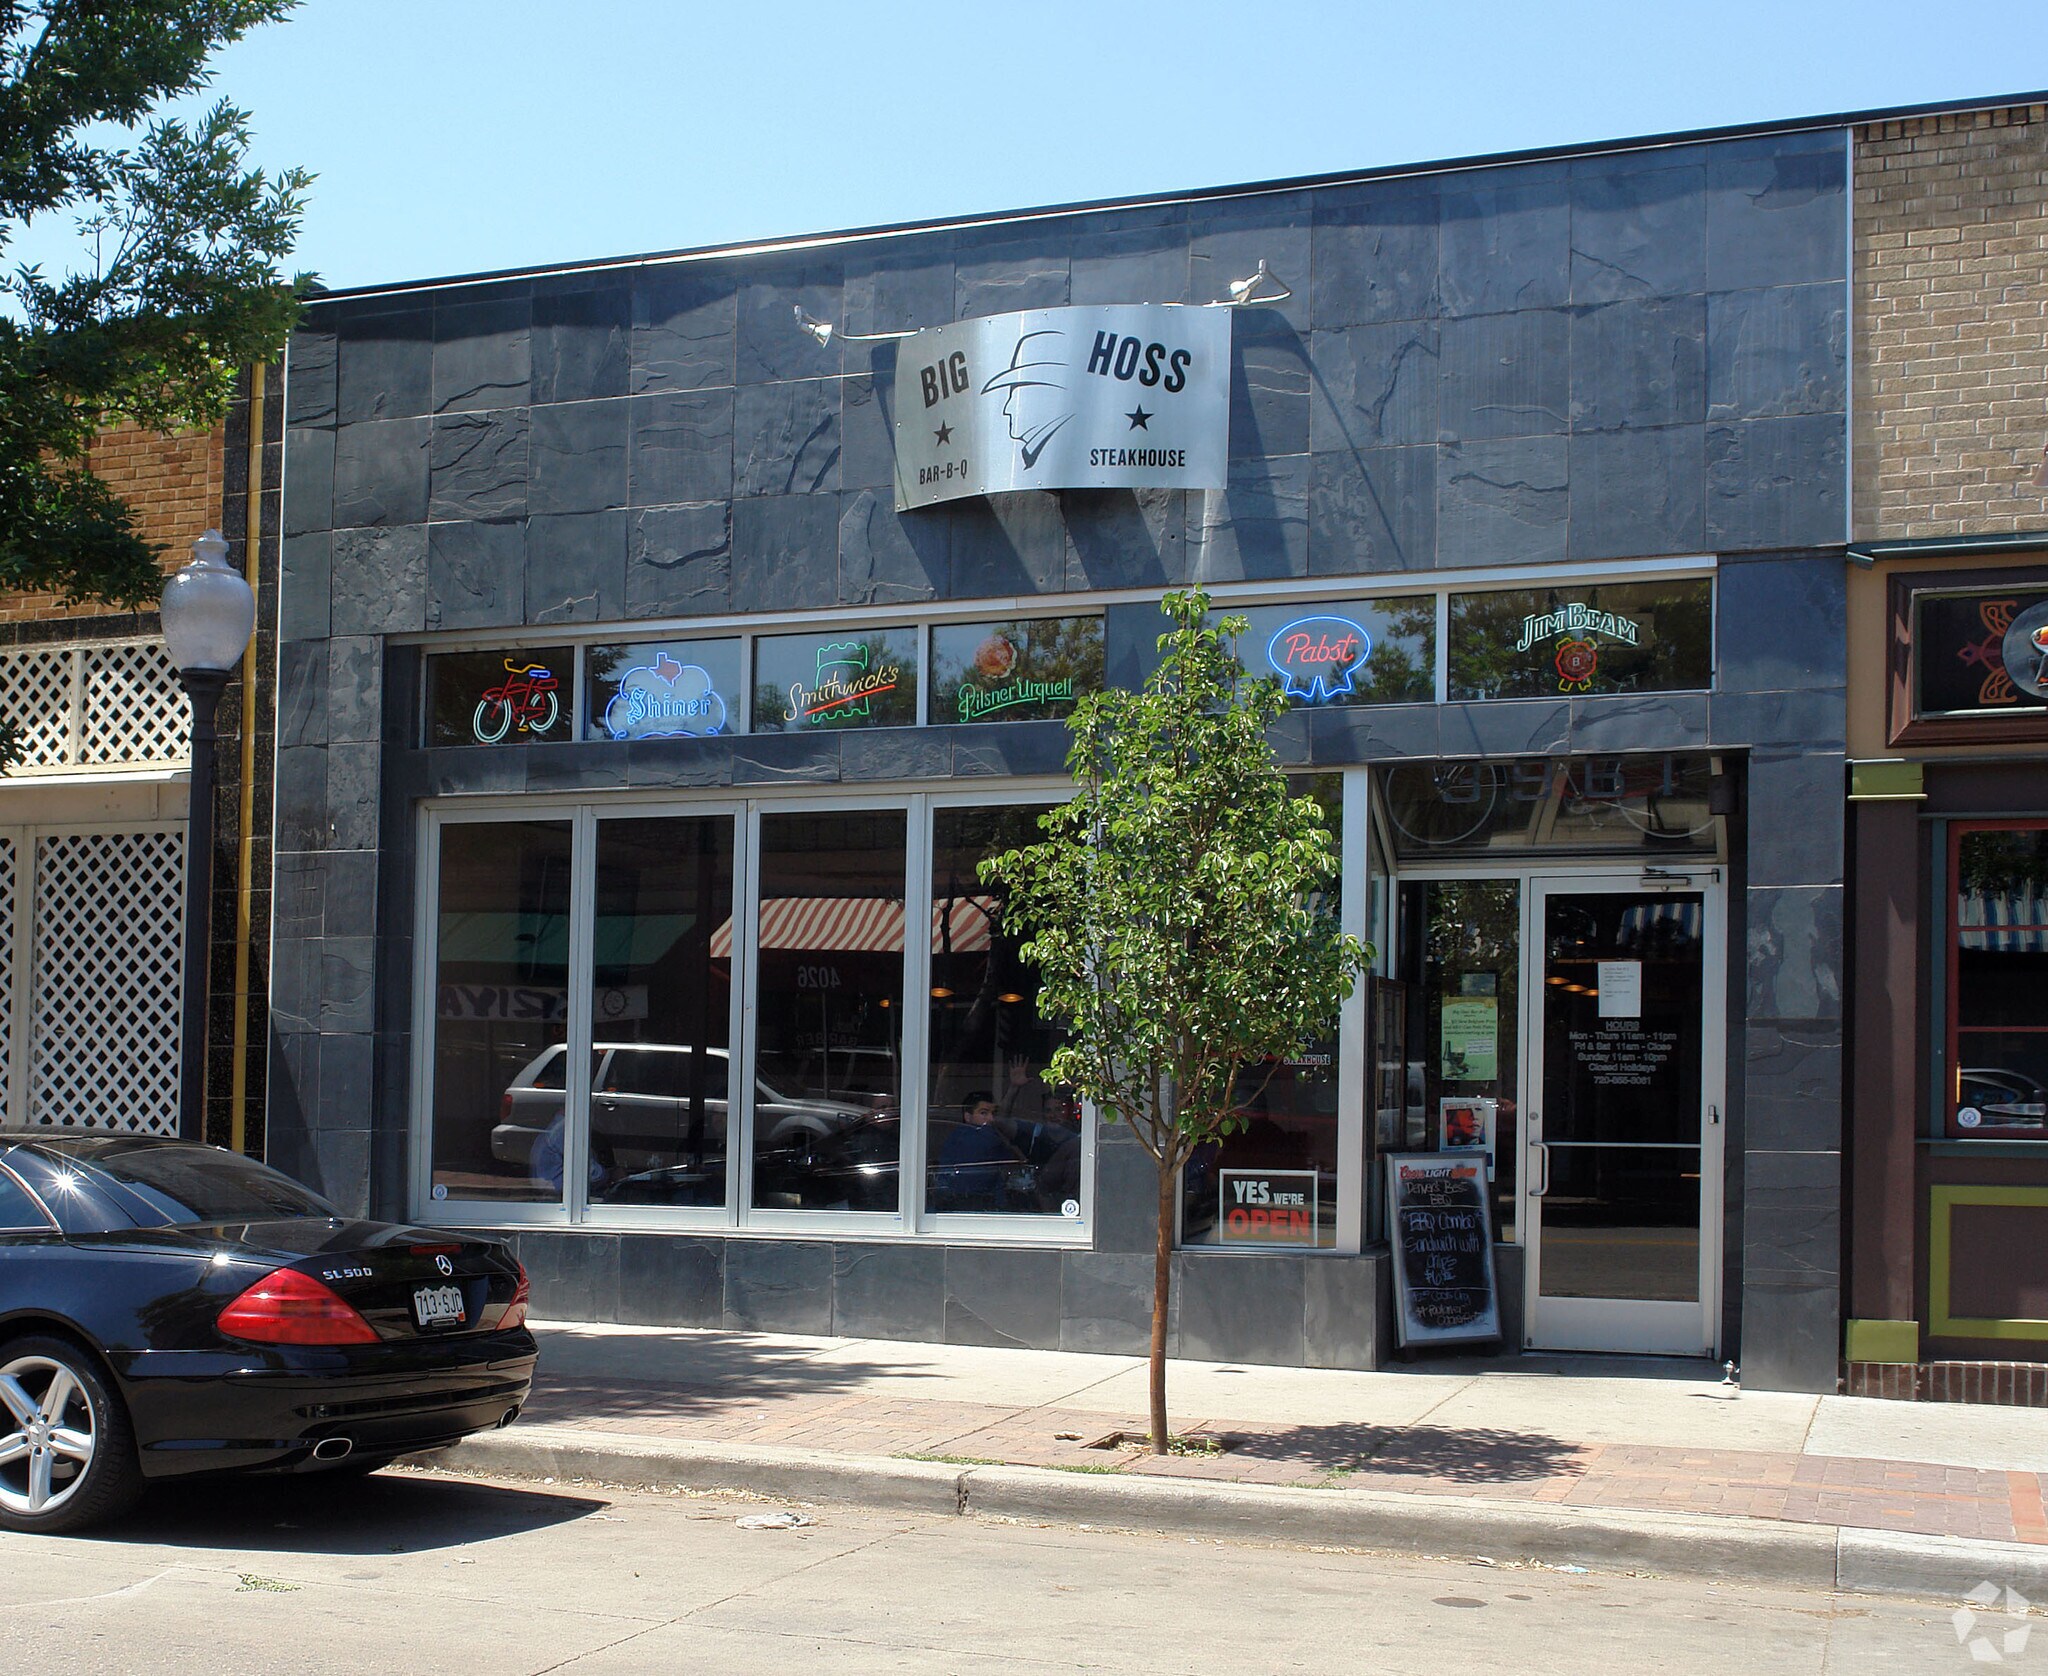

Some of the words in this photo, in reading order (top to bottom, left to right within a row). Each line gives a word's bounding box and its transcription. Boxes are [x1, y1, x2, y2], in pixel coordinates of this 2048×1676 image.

[920, 350, 970, 408] BIG
[1087, 330, 1192, 394] HOSS
[919, 459, 968, 485] BAR-B-Q
[1089, 448, 1186, 467] STEAKHOUSE
[1285, 632, 1359, 664] Pabst
[626, 686, 713, 726] Shiner
[782, 662, 900, 722] Smithwick's
[956, 680, 1016, 724] Pilsner
[1016, 675, 1073, 704] Urquell
[1605, 1020, 1640, 1030] HOURS
[1425, 1168, 1452, 1178] LIGHT
[1232, 1180, 1270, 1205] YES
[1273, 1192, 1305, 1206] WE'RE
[1228, 1208, 1311, 1237] OPEN
